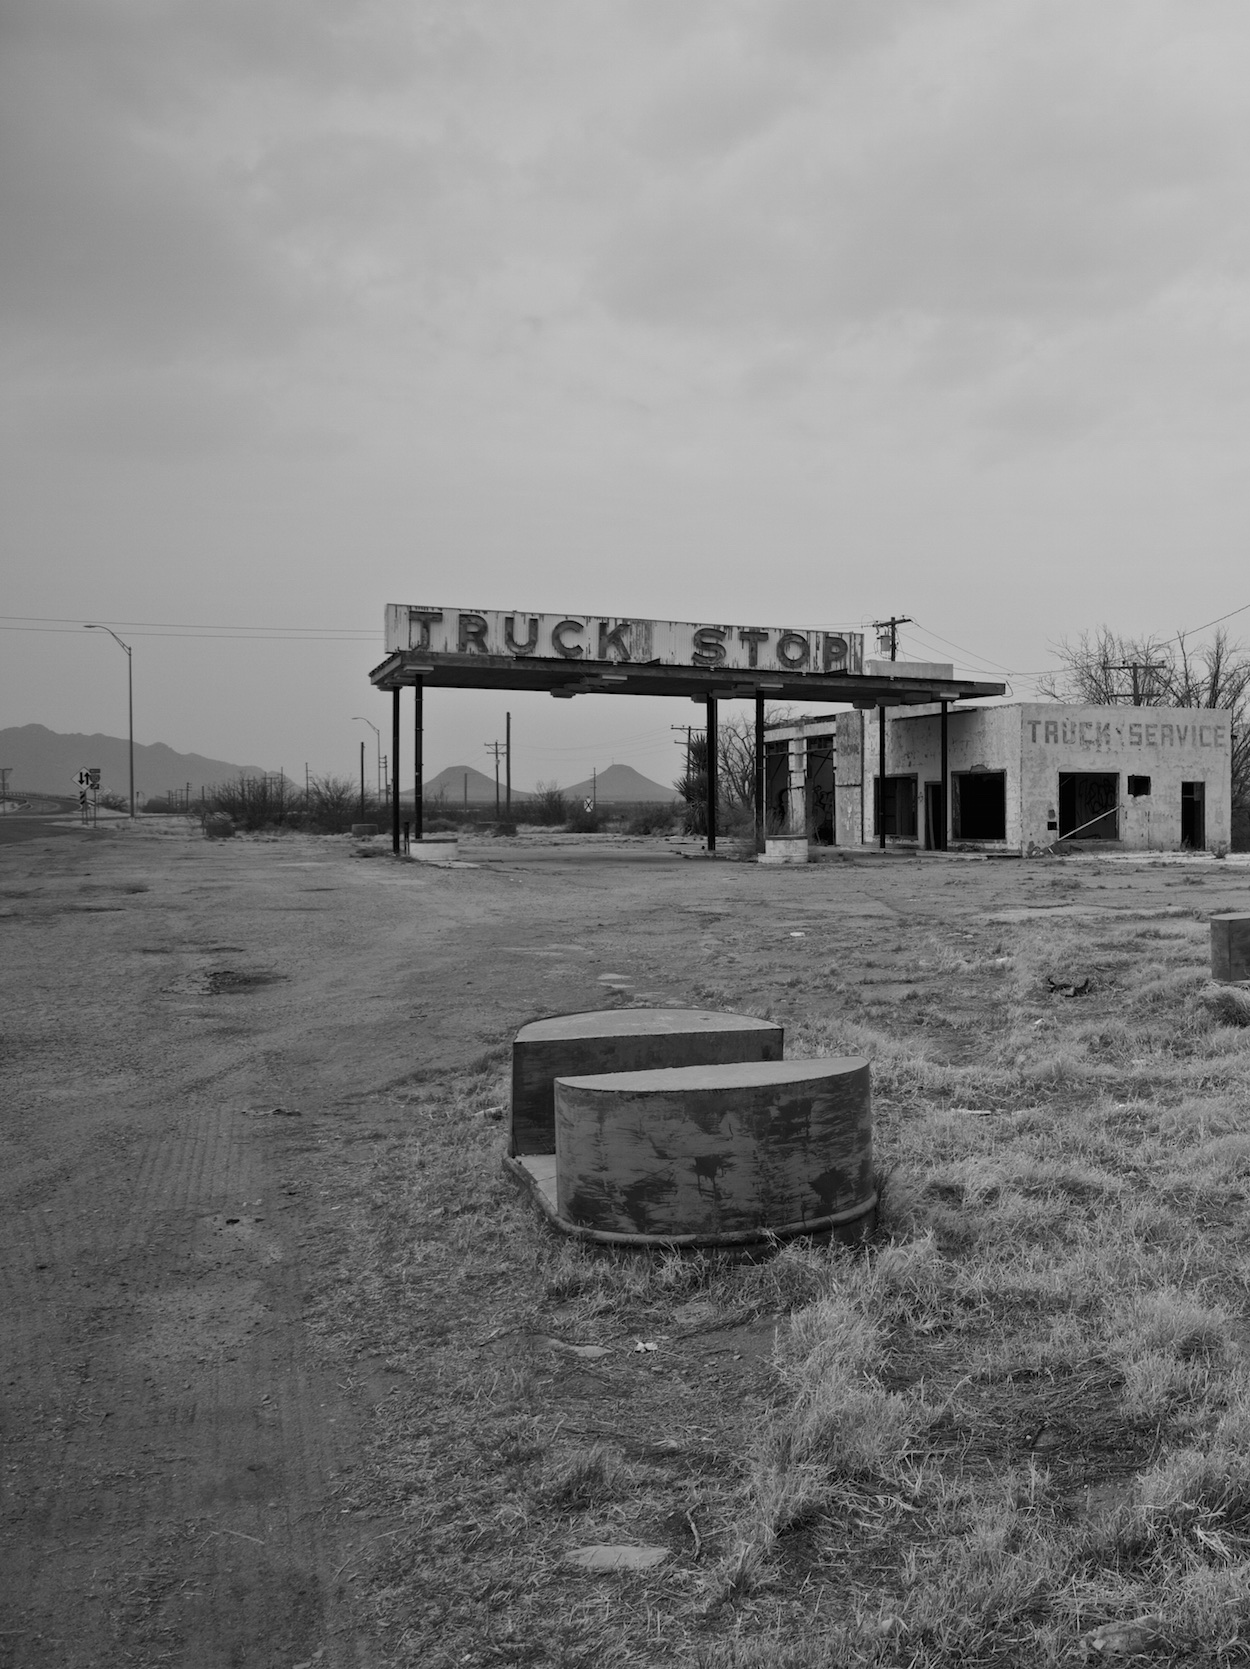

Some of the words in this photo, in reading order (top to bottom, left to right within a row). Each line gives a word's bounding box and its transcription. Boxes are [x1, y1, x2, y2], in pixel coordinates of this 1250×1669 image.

[408, 610, 632, 660] TRUCK
[691, 627, 848, 669] STOP
[1027, 719, 1112, 746] TRUCK
[1129, 723, 1226, 748] SERVICE
